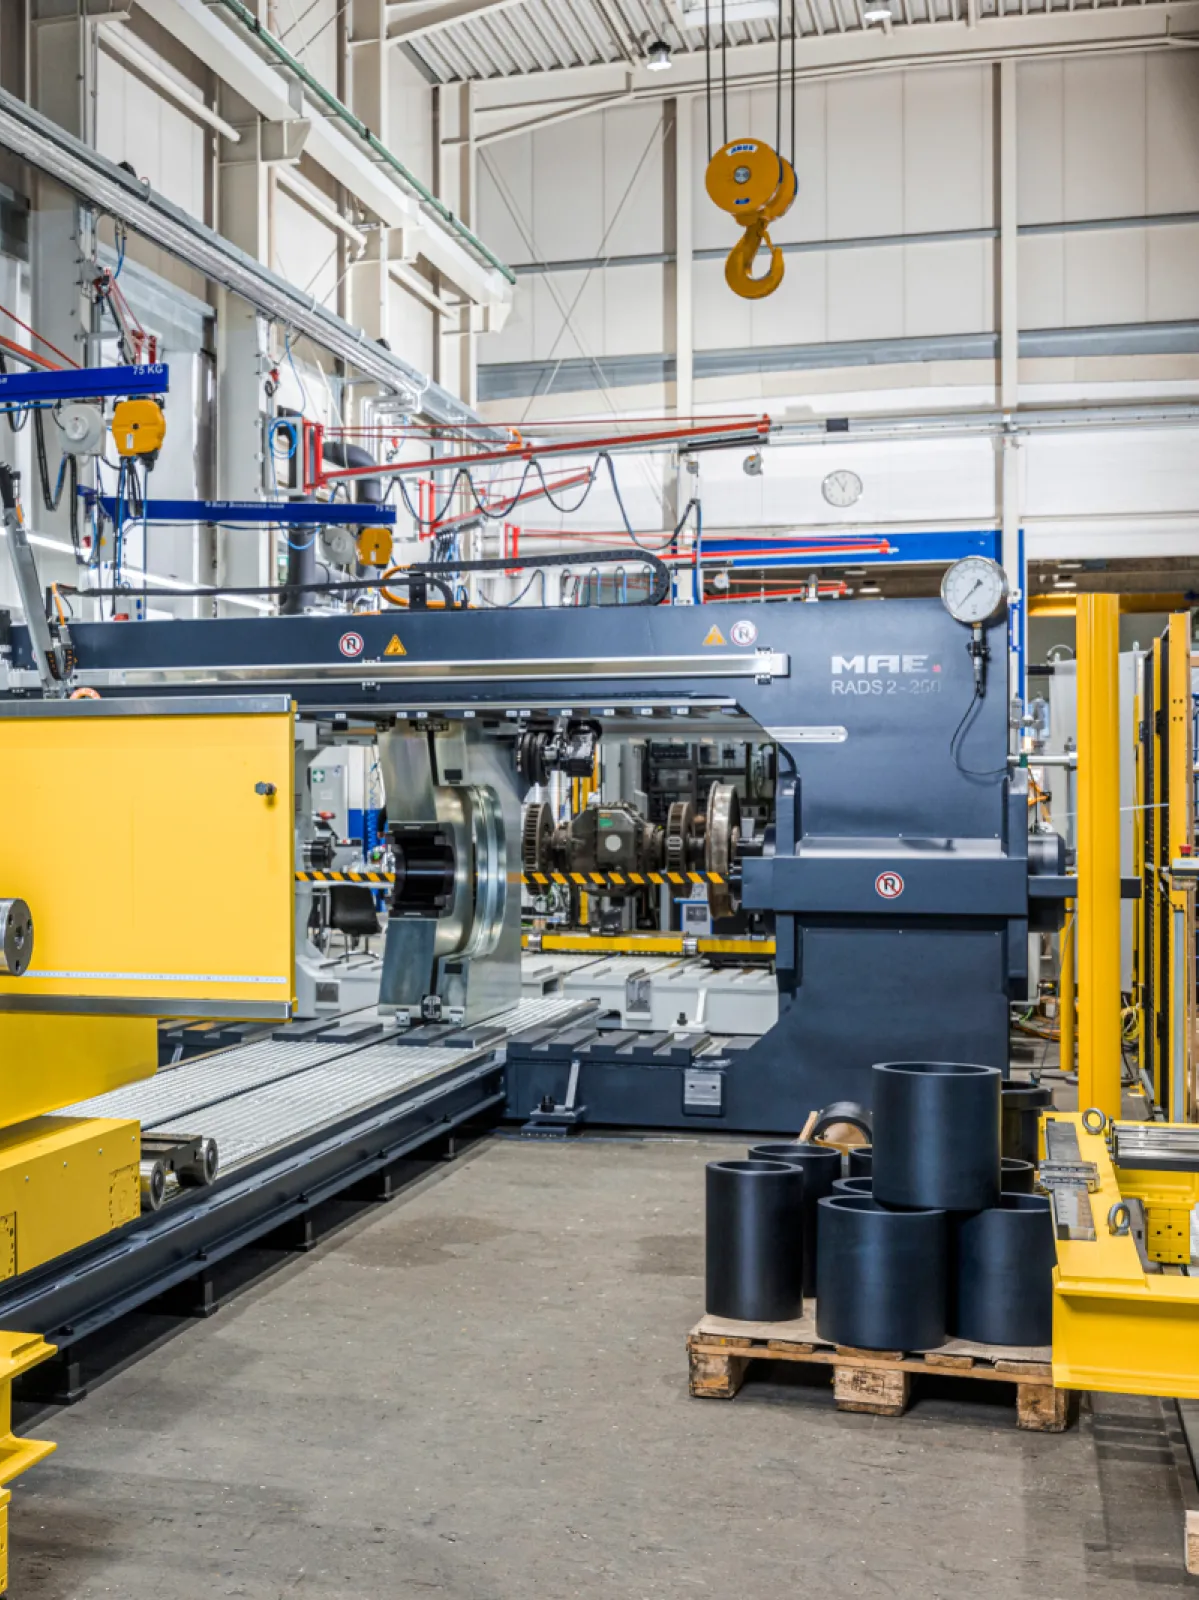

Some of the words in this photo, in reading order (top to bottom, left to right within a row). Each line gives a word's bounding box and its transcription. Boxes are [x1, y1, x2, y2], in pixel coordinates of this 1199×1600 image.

[133, 365, 144, 375] 75
[147, 364, 164, 374] KG
[831, 680, 883, 695] RADS
